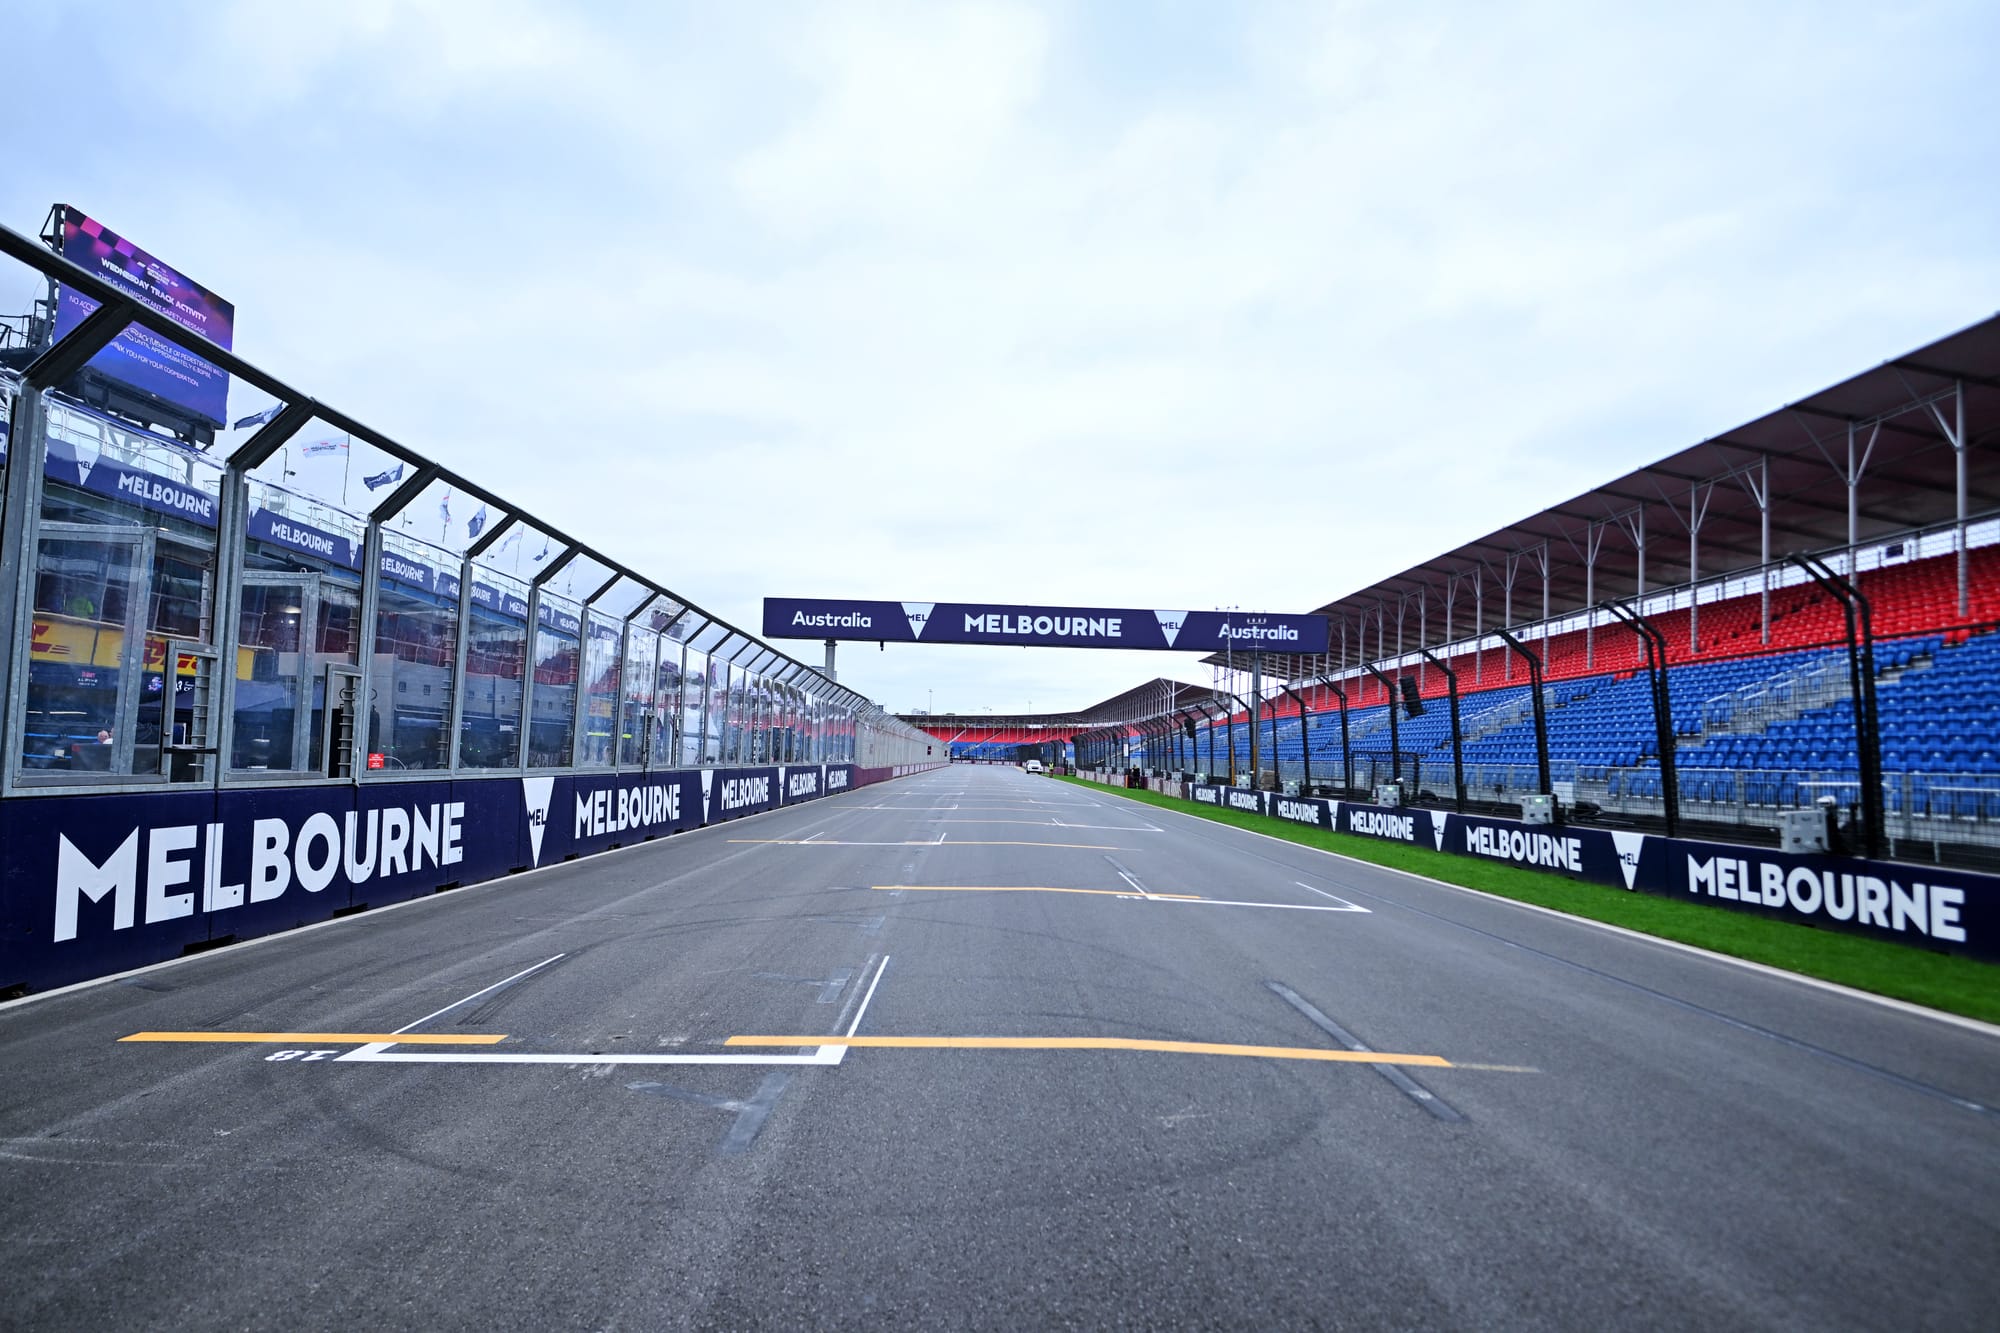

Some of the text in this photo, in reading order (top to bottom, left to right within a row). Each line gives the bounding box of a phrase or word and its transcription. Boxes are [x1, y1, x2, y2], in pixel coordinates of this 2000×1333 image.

[69, 295, 79, 305] NO
[101, 257, 150, 291] WEDNESDAY
[150, 285, 175, 306] TRACK
[176, 300, 207, 323] ACTIVITY
[162, 306, 182, 322] SAFETY
[77, 460, 92, 470] MEL
[118, 471, 212, 519] MELBOURNE
[270, 521, 334, 556] MELBOURNE
[792, 610, 871, 627] Australia
[907, 613, 928, 622] MEL
[964, 612, 1121, 637] MELBOURNE
[1160, 621, 1180, 630] MEL
[1218, 623, 1298, 641] Australia
[789, 772, 816, 797] MELBOURNE
[828, 770, 847, 789] MELBOURNE
[721, 777, 769, 810] MELBOURNE
[1195, 787, 1216, 804] MELBOURNE
[1229, 791, 1258, 812] MELBOURNE
[529, 808, 545, 827] MEL
[575, 784, 681, 839] MELBOURNE
[1277, 800, 1319, 824] MELBOURNE
[1349, 810, 1414, 841] MELBOURNE
[1466, 825, 1583, 872] MELBOURNE
[1619, 852, 1639, 866] MEL
[53, 801, 465, 943] MELBOURNE
[1687, 853, 1966, 943] MELBOURNE
